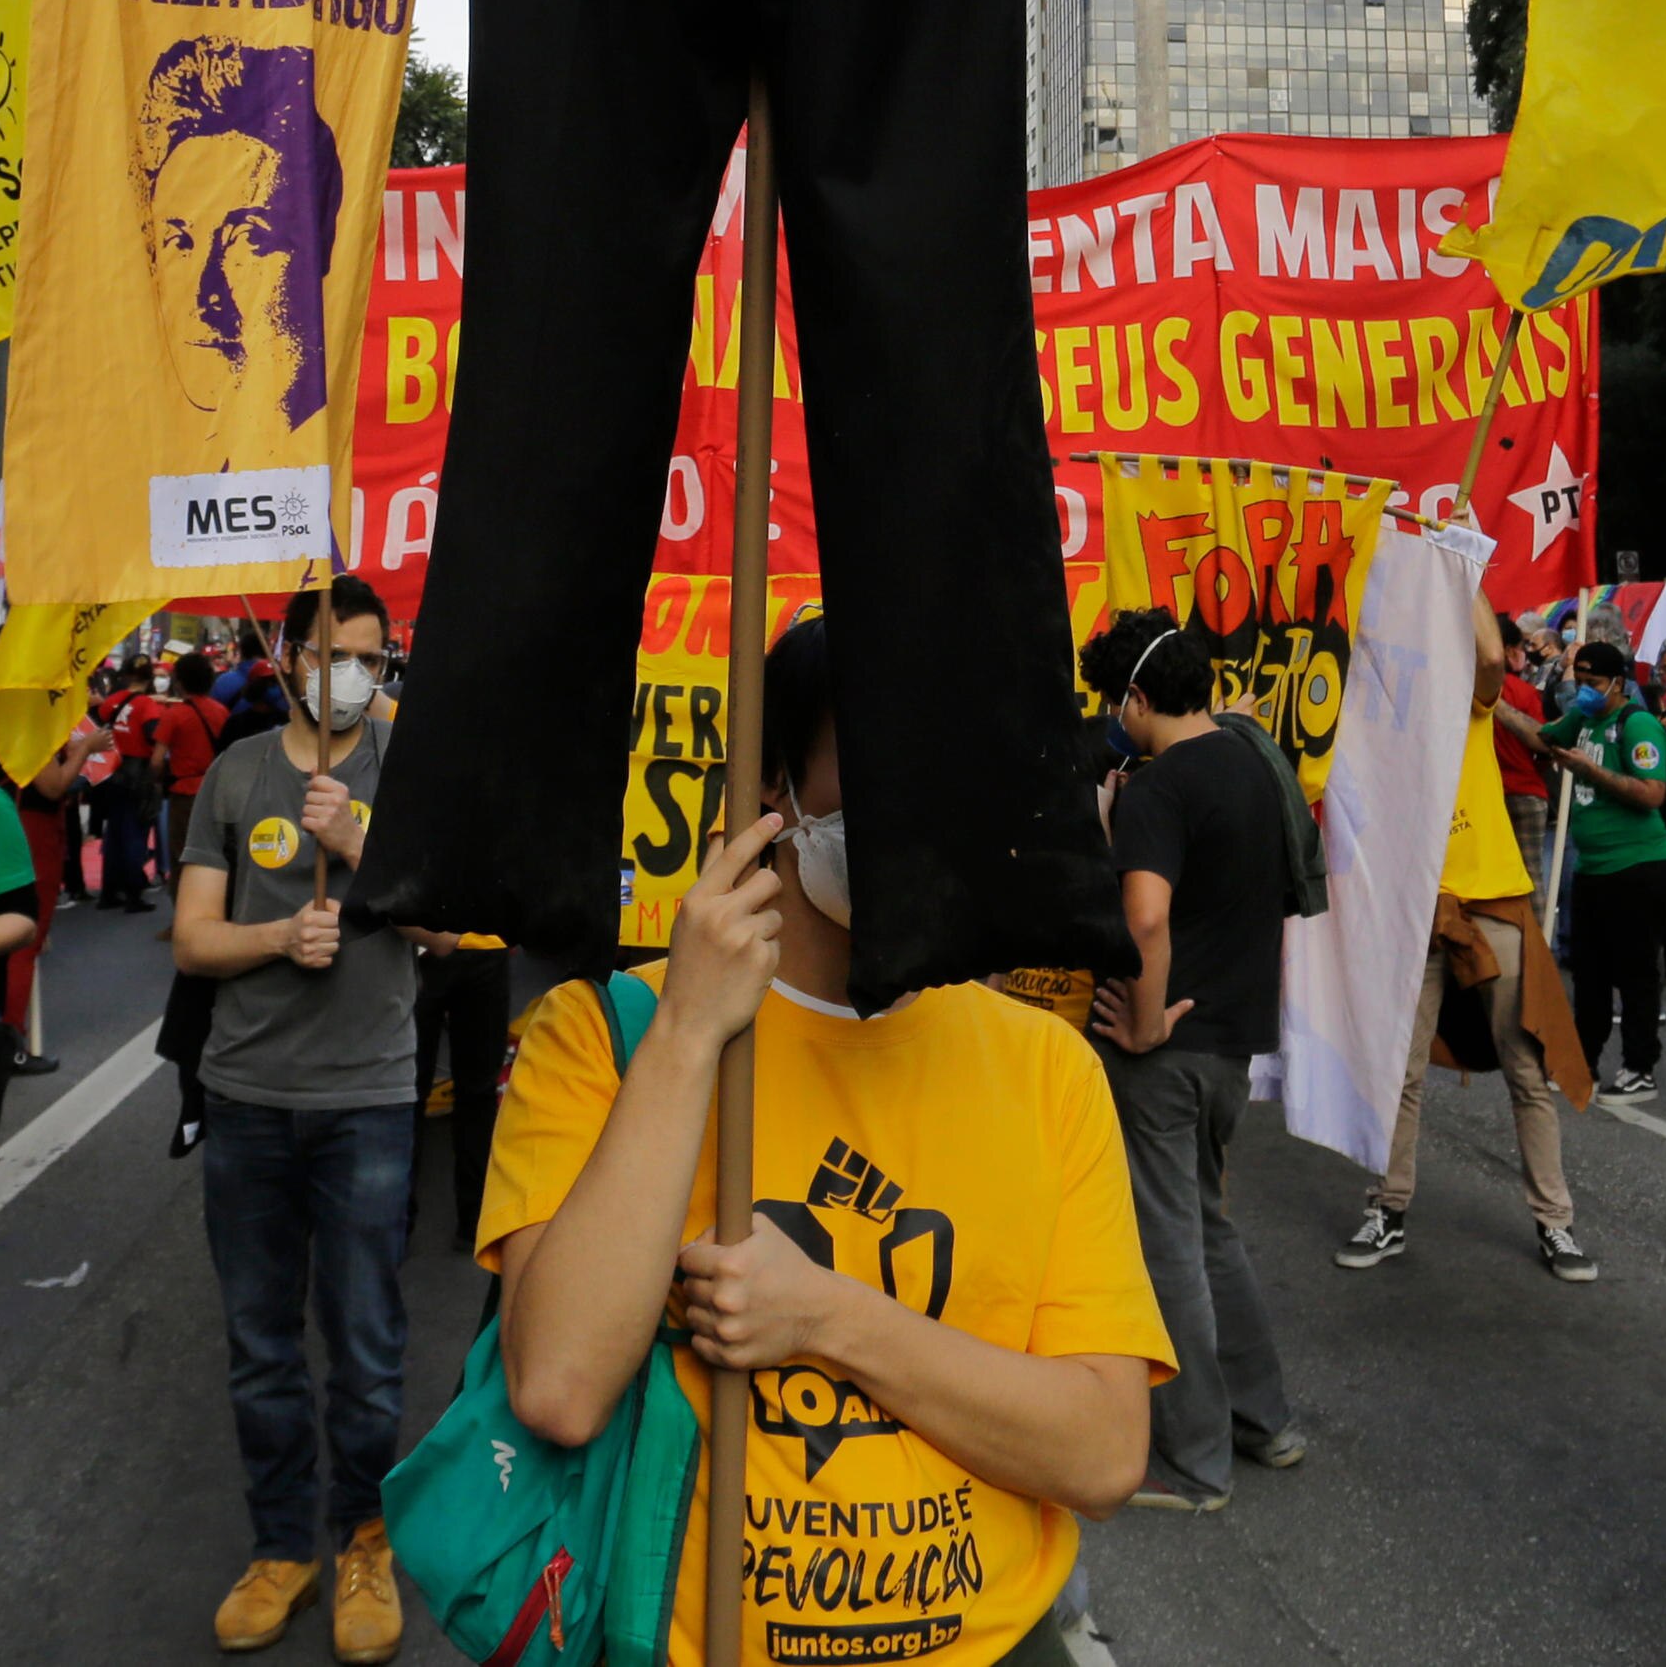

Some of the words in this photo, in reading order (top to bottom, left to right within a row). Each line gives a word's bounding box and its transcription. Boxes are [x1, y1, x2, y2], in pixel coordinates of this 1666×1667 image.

[187, 495, 277, 535] MES
[1541, 485, 1580, 524] PT
[281, 524, 311, 537] PSOL
[1137, 499, 1355, 635] FORA
[754, 1370, 837, 1428] 10
[954, 1478, 973, 1524] É
[771, 1621, 960, 1659] juntos.org.br
